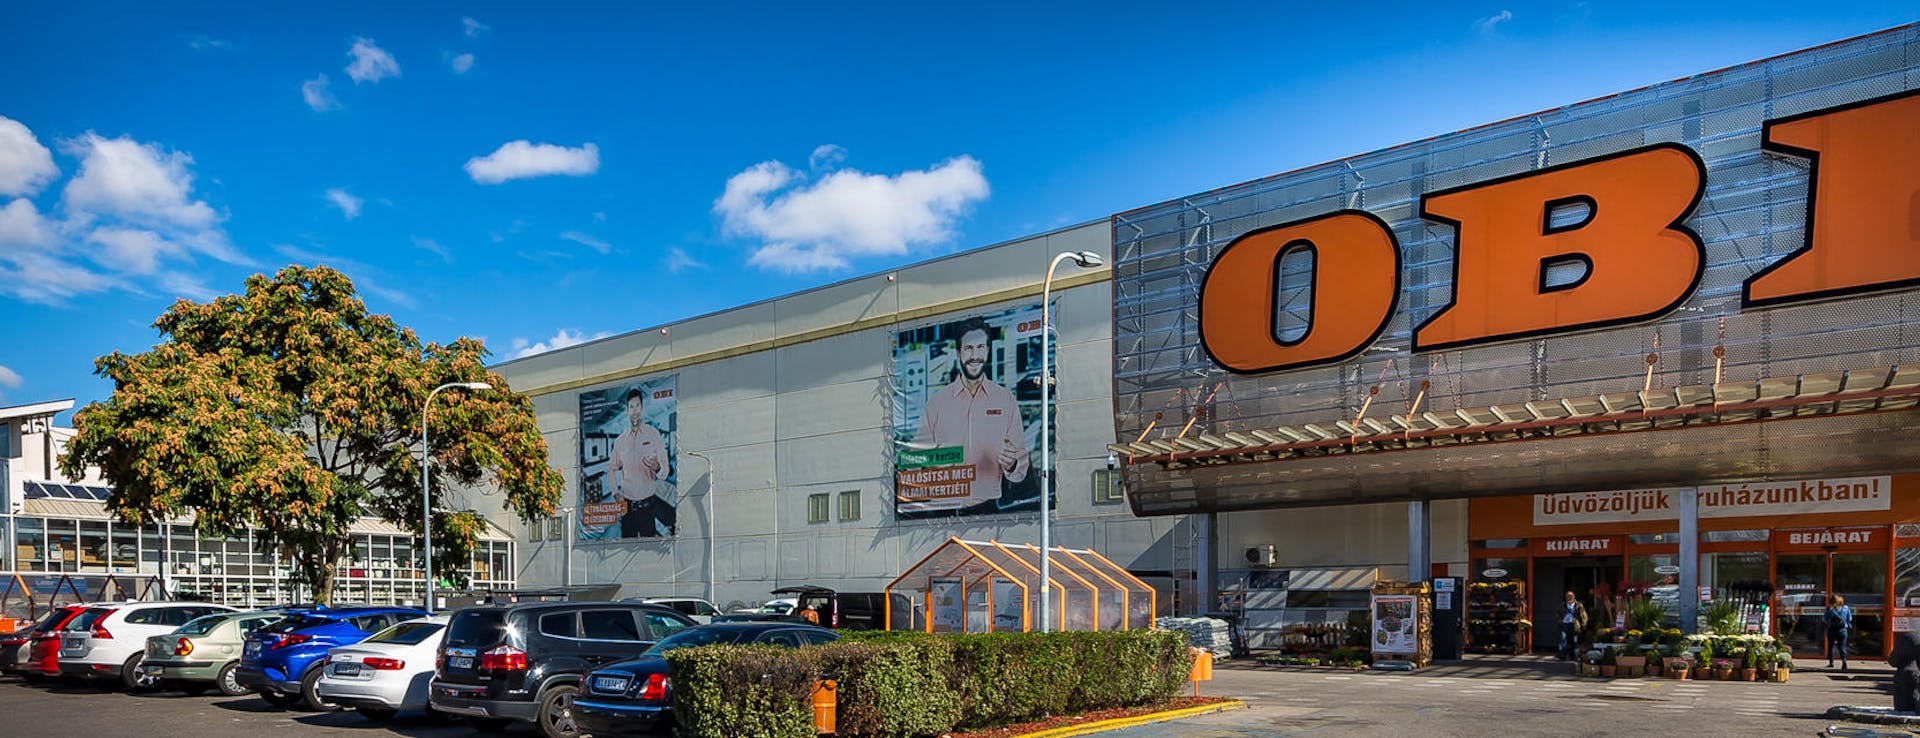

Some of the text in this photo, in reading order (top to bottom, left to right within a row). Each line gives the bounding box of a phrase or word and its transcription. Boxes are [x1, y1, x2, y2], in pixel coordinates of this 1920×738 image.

[1017, 320, 1041, 333] OB
[653, 389, 673, 400] OBI
[900, 467, 973, 484] VALÓSÍTSA MEG
[901, 481, 968, 498] ÁLMAI KERTJÉT!
[1543, 478, 1879, 515] Üdvözöljük ruházunkban!
[1546, 537, 1610, 551] KIJÁRAT
[1789, 529, 1873, 544] BEJÁRAT
